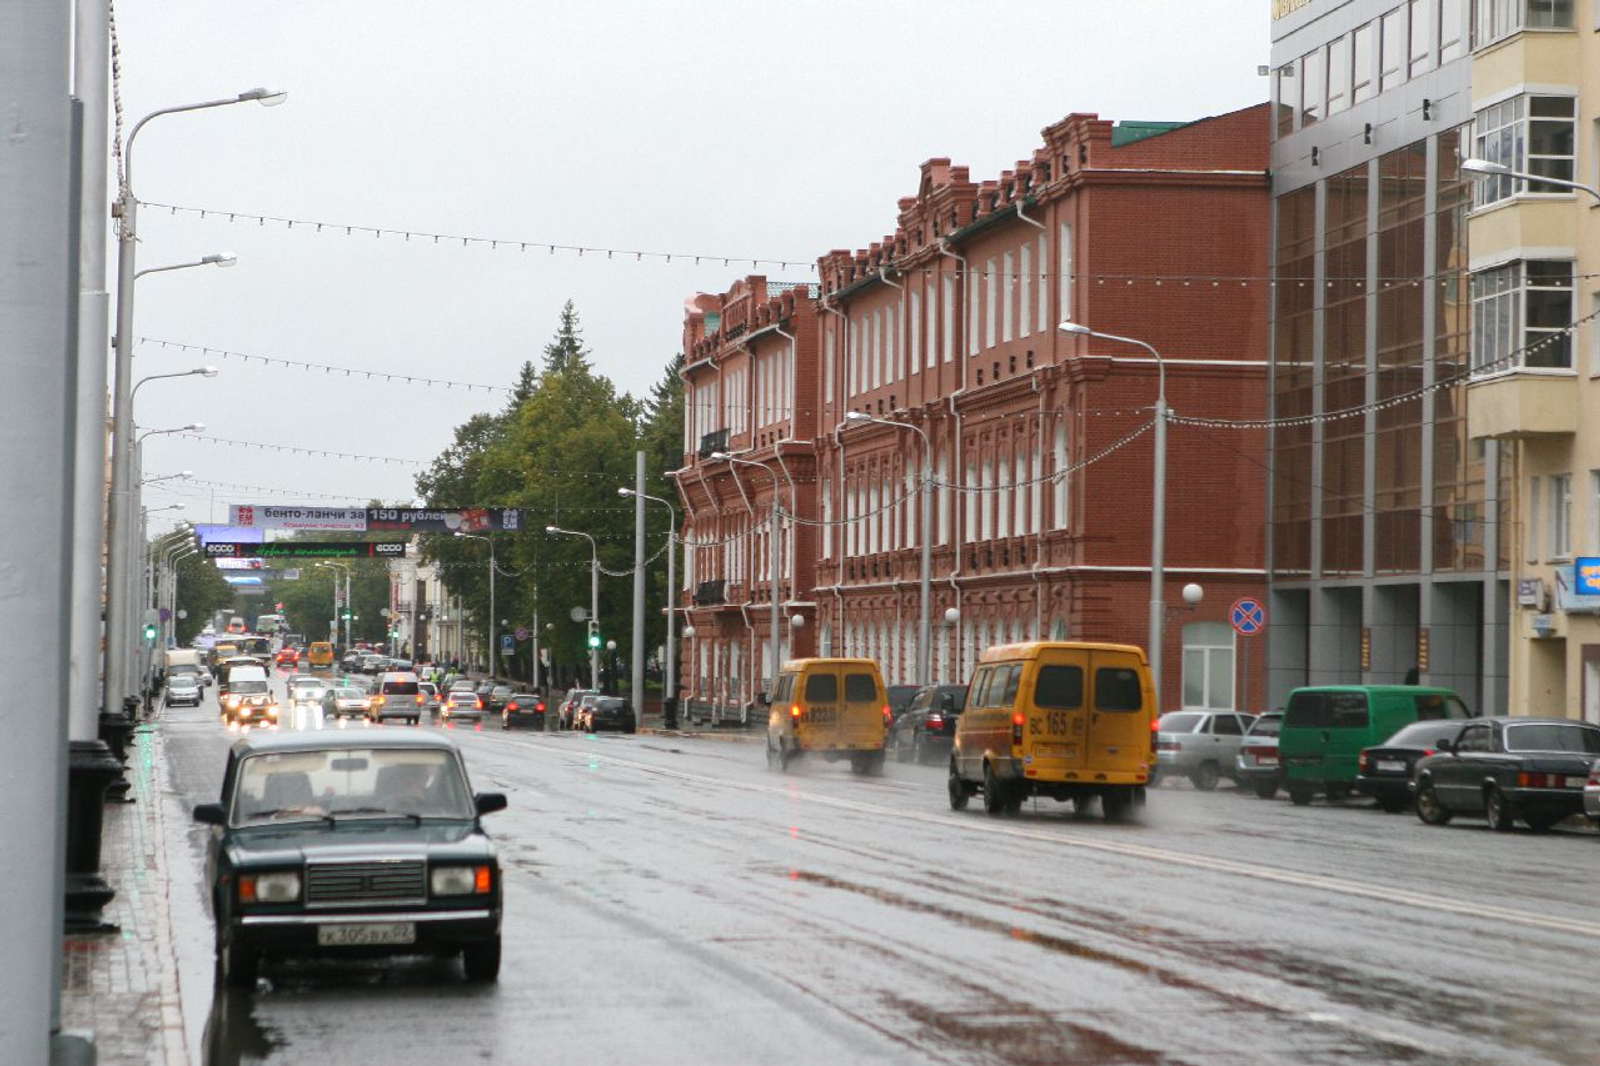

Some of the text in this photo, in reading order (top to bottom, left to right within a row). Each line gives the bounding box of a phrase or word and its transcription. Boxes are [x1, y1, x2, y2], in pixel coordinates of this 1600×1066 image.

[264, 508, 448, 523] бенто-ланчи за 150 рублей
[1047, 711, 1067, 735] 165
